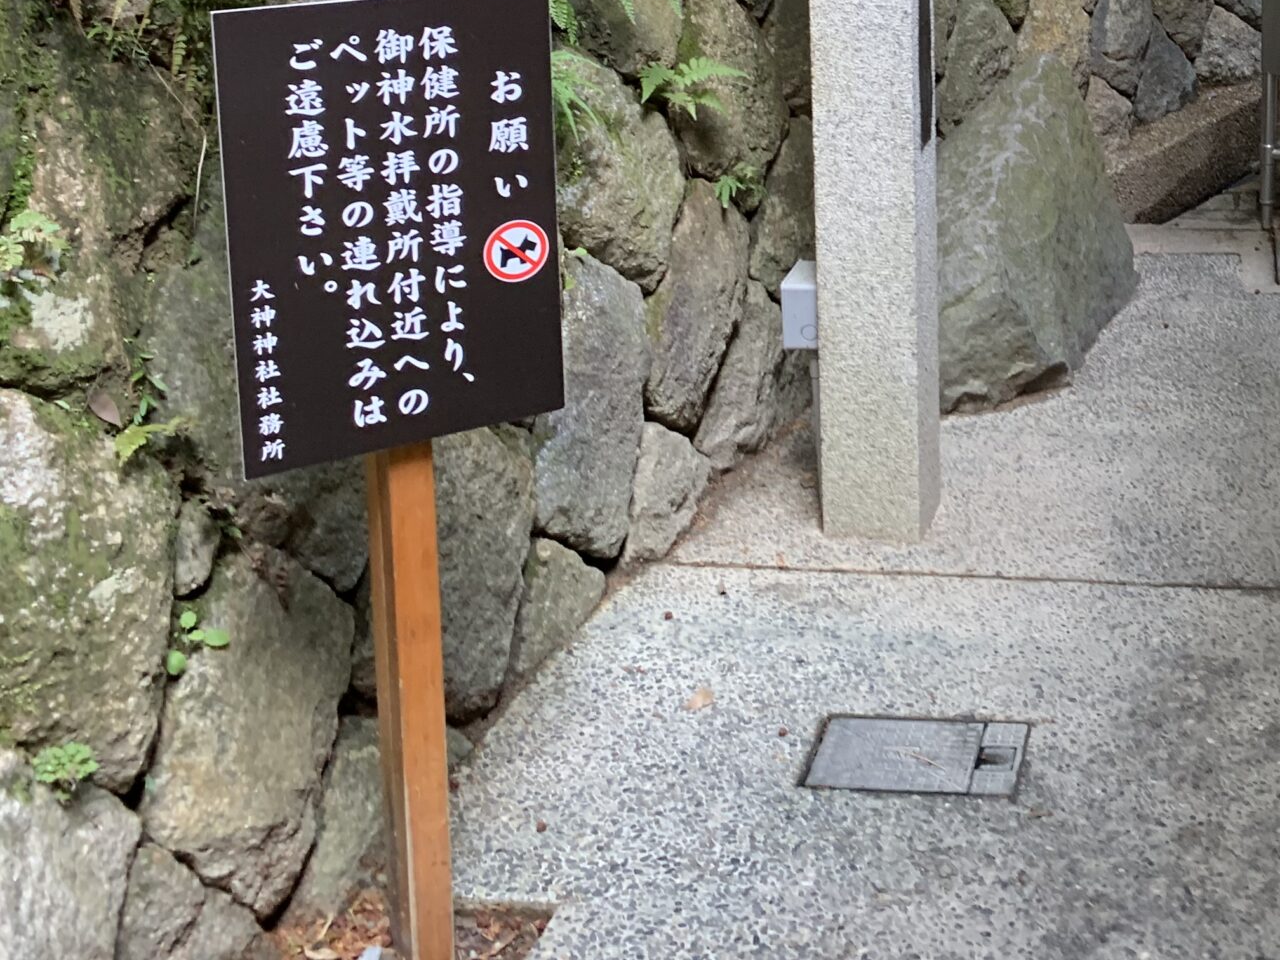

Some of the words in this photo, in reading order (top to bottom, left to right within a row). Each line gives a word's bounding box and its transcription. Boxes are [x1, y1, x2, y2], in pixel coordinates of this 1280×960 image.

[284, 38, 339, 295] ご遠慮下さい。
[329, 34, 388, 428] ペット等の連れ込みは
[374, 28, 431, 416] 御神水拝戴所付近への
[418, 25, 476, 383] 保健所の指導により、
[487, 70, 529, 198] お願い
[249, 279, 285, 462] 大神神社社務所
